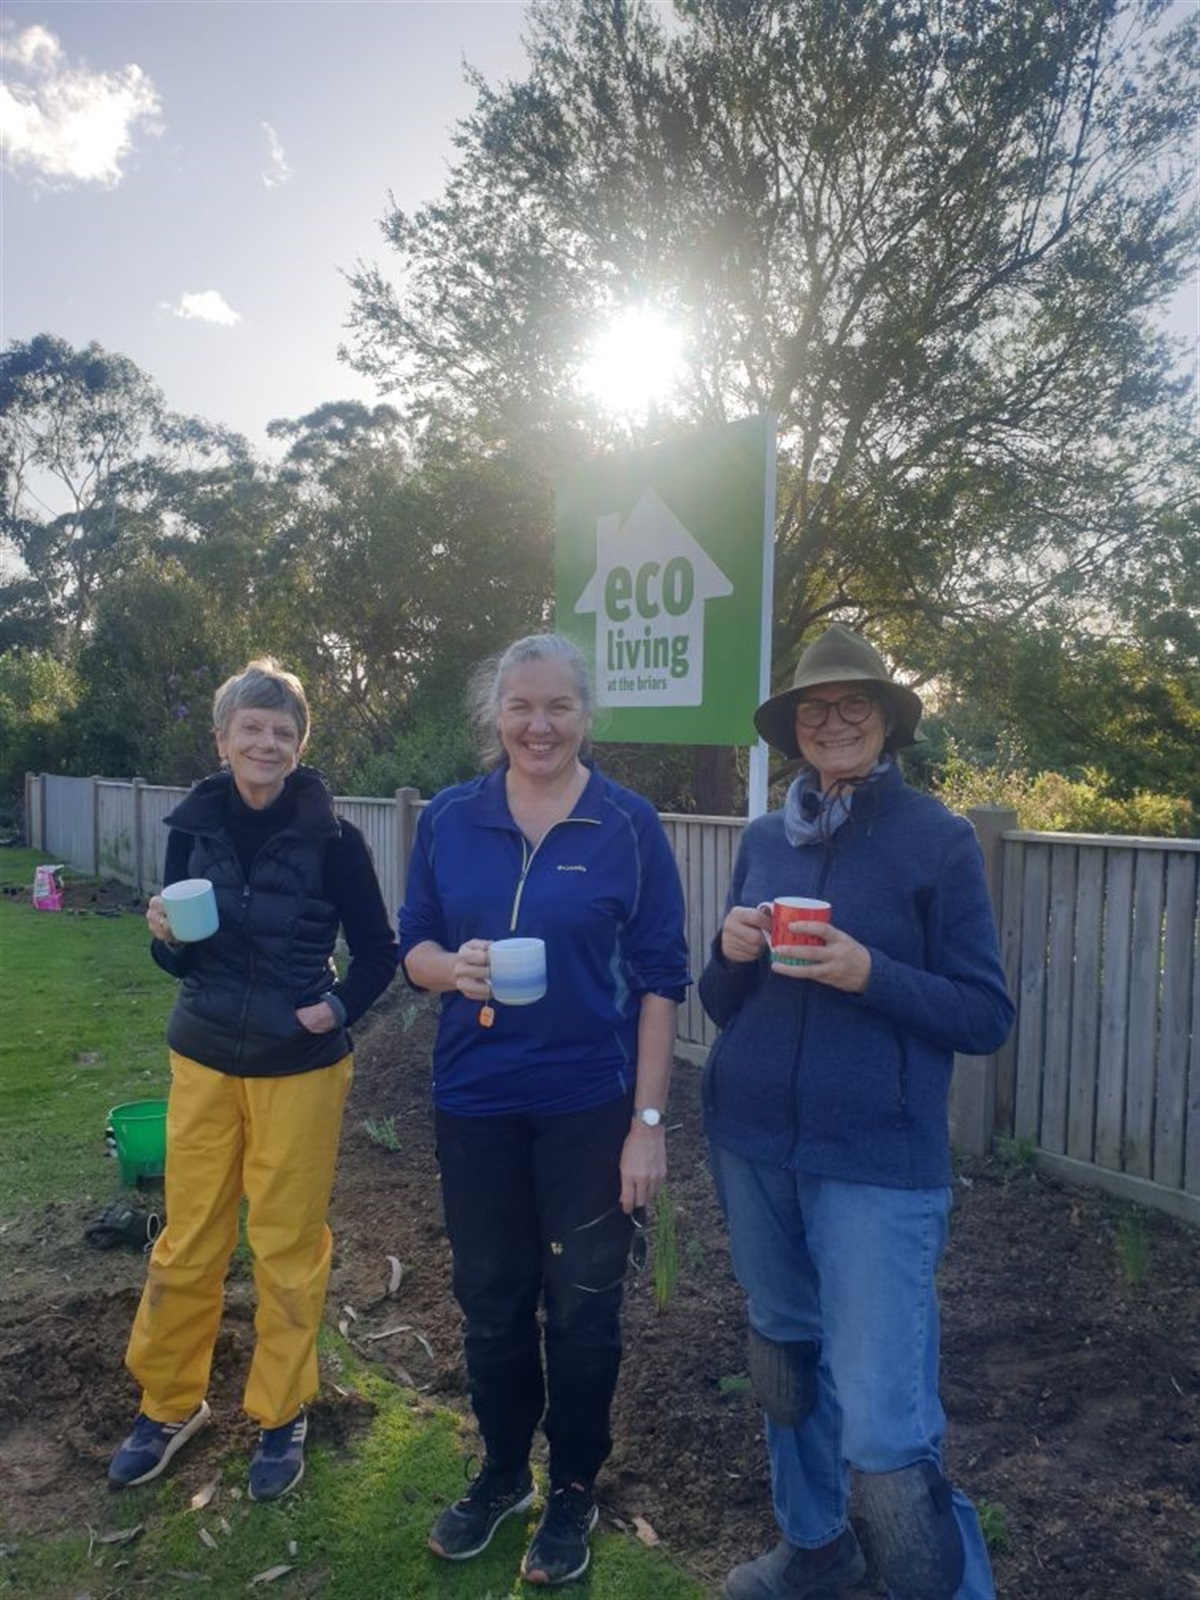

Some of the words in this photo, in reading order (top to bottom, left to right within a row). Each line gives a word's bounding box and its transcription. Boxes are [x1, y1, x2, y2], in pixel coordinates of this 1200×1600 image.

[605, 556, 694, 622] eco
[607, 625, 689, 678] living
[607, 677, 617, 691] at
[618, 676, 635, 691] the
[637, 675, 667, 690] briars
